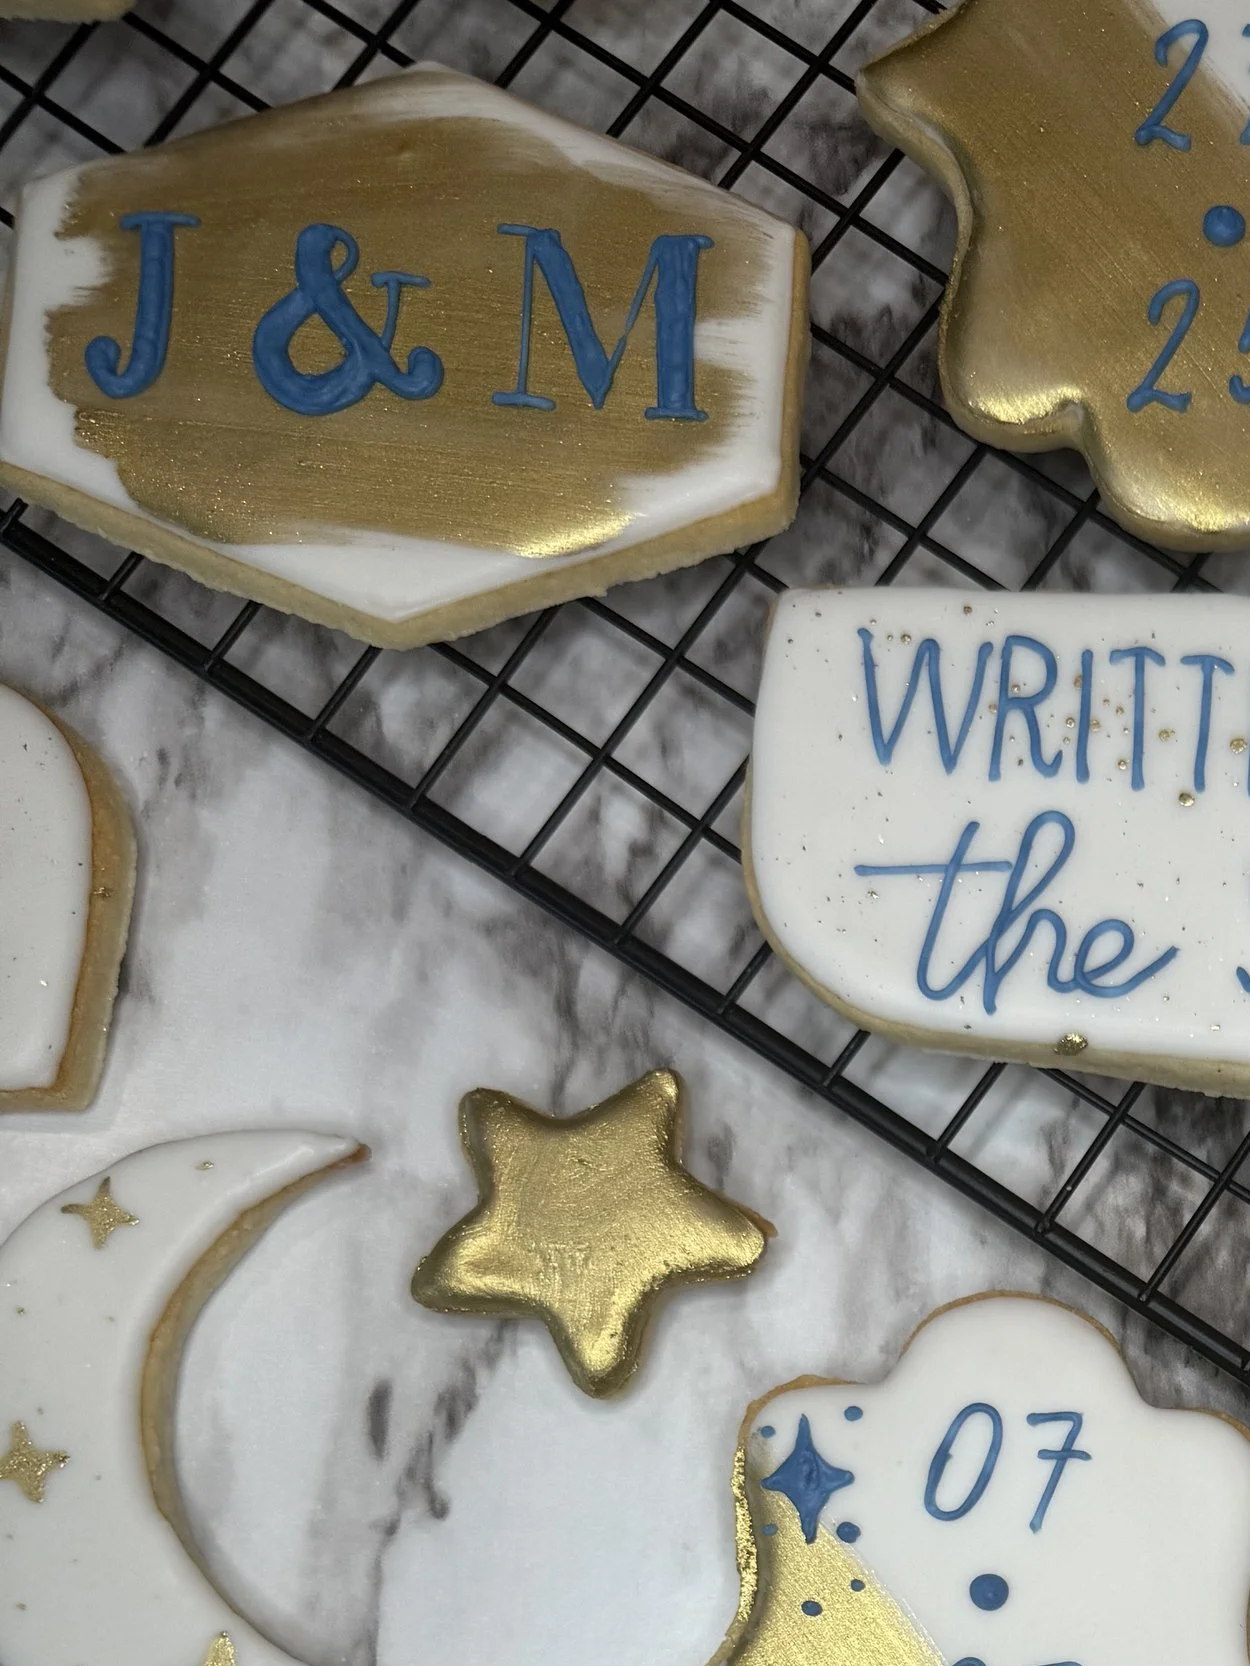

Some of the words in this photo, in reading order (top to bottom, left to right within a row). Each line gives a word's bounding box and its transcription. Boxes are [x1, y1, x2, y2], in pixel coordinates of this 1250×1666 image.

[84, 210, 201, 400] J
[252, 222, 444, 417] &
[491, 223, 715, 422] M
[853, 808, 1178, 1016] the
[922, 1400, 1092, 1533] 07
